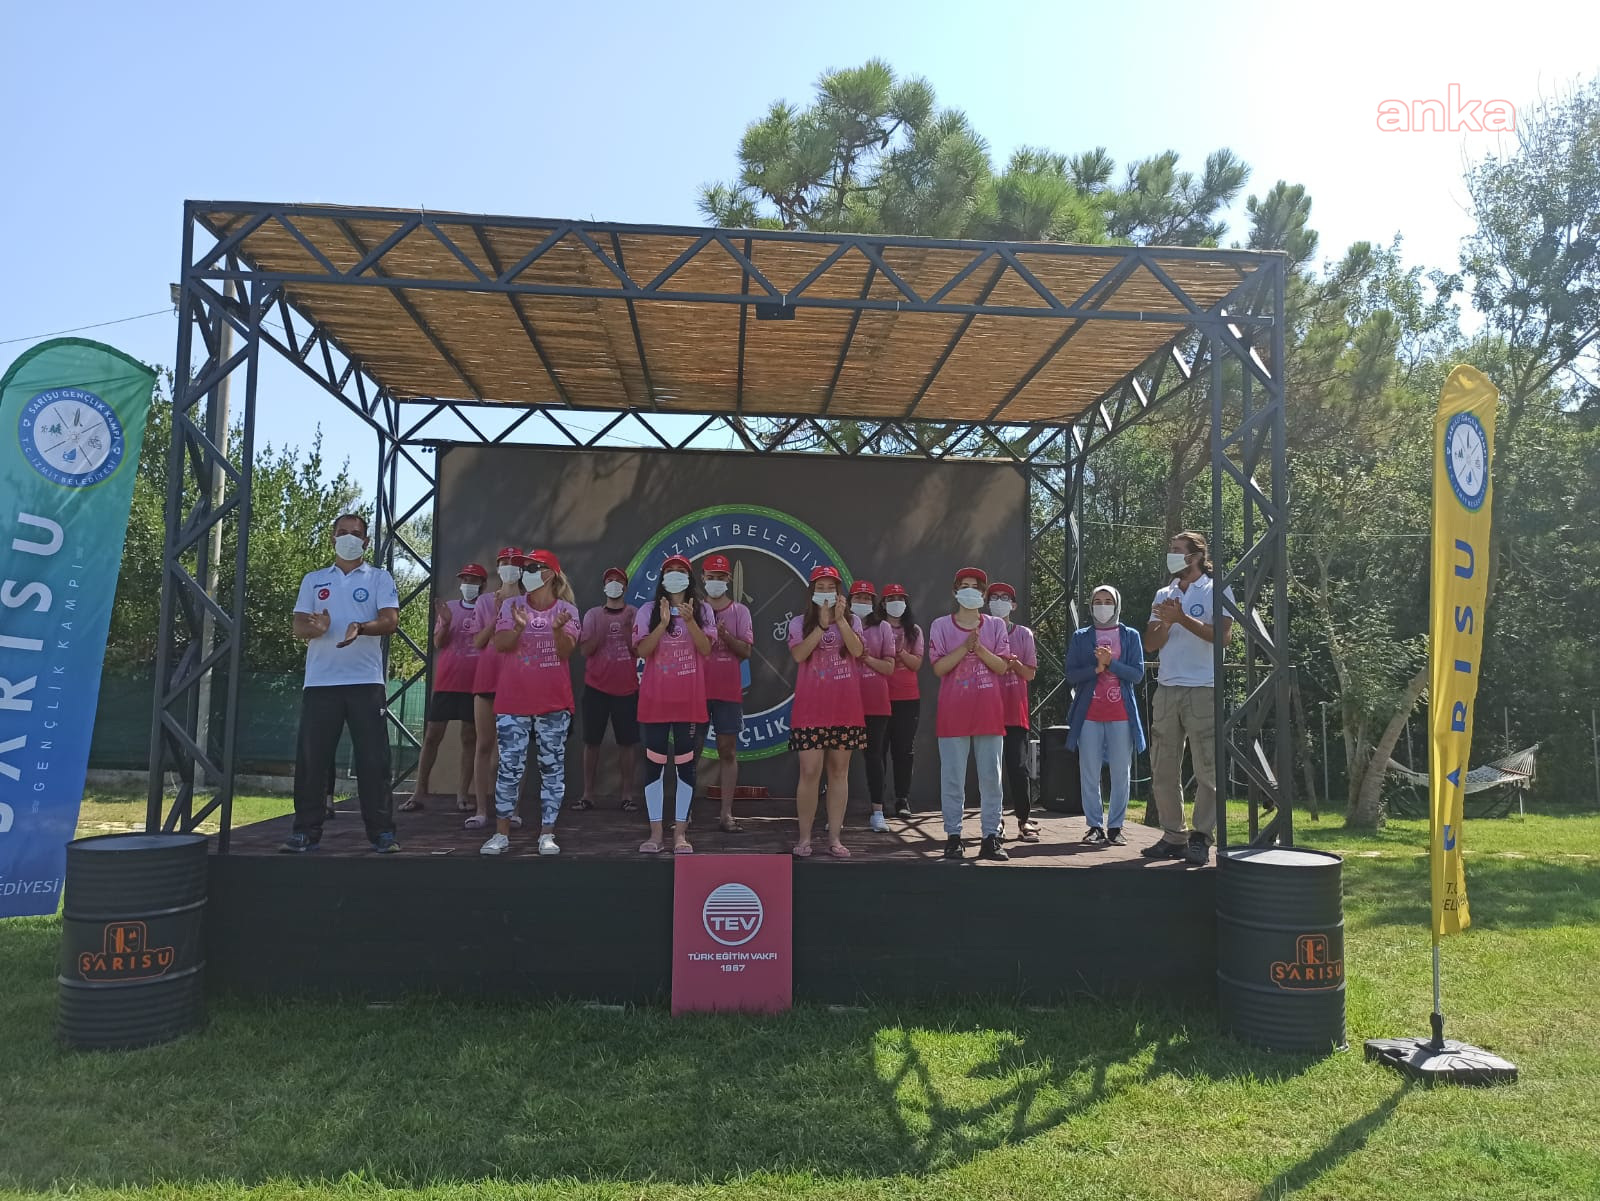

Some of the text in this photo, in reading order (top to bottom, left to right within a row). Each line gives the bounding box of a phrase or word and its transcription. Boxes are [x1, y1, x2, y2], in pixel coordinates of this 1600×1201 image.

[29, 391, 59, 414] SARISU
[732, 523, 821, 570] BELEDİY
[57, 564, 83, 650] KAMPI
[0, 511, 64, 832] ARISU
[710, 916, 757, 931] TEV
[82, 952, 170, 972] SARISU
[687, 951, 778, 961] TÜRK EĞİTİM VAKFI
[720, 964, 746, 972] 1967
[1275, 964, 1342, 980] SARISU
